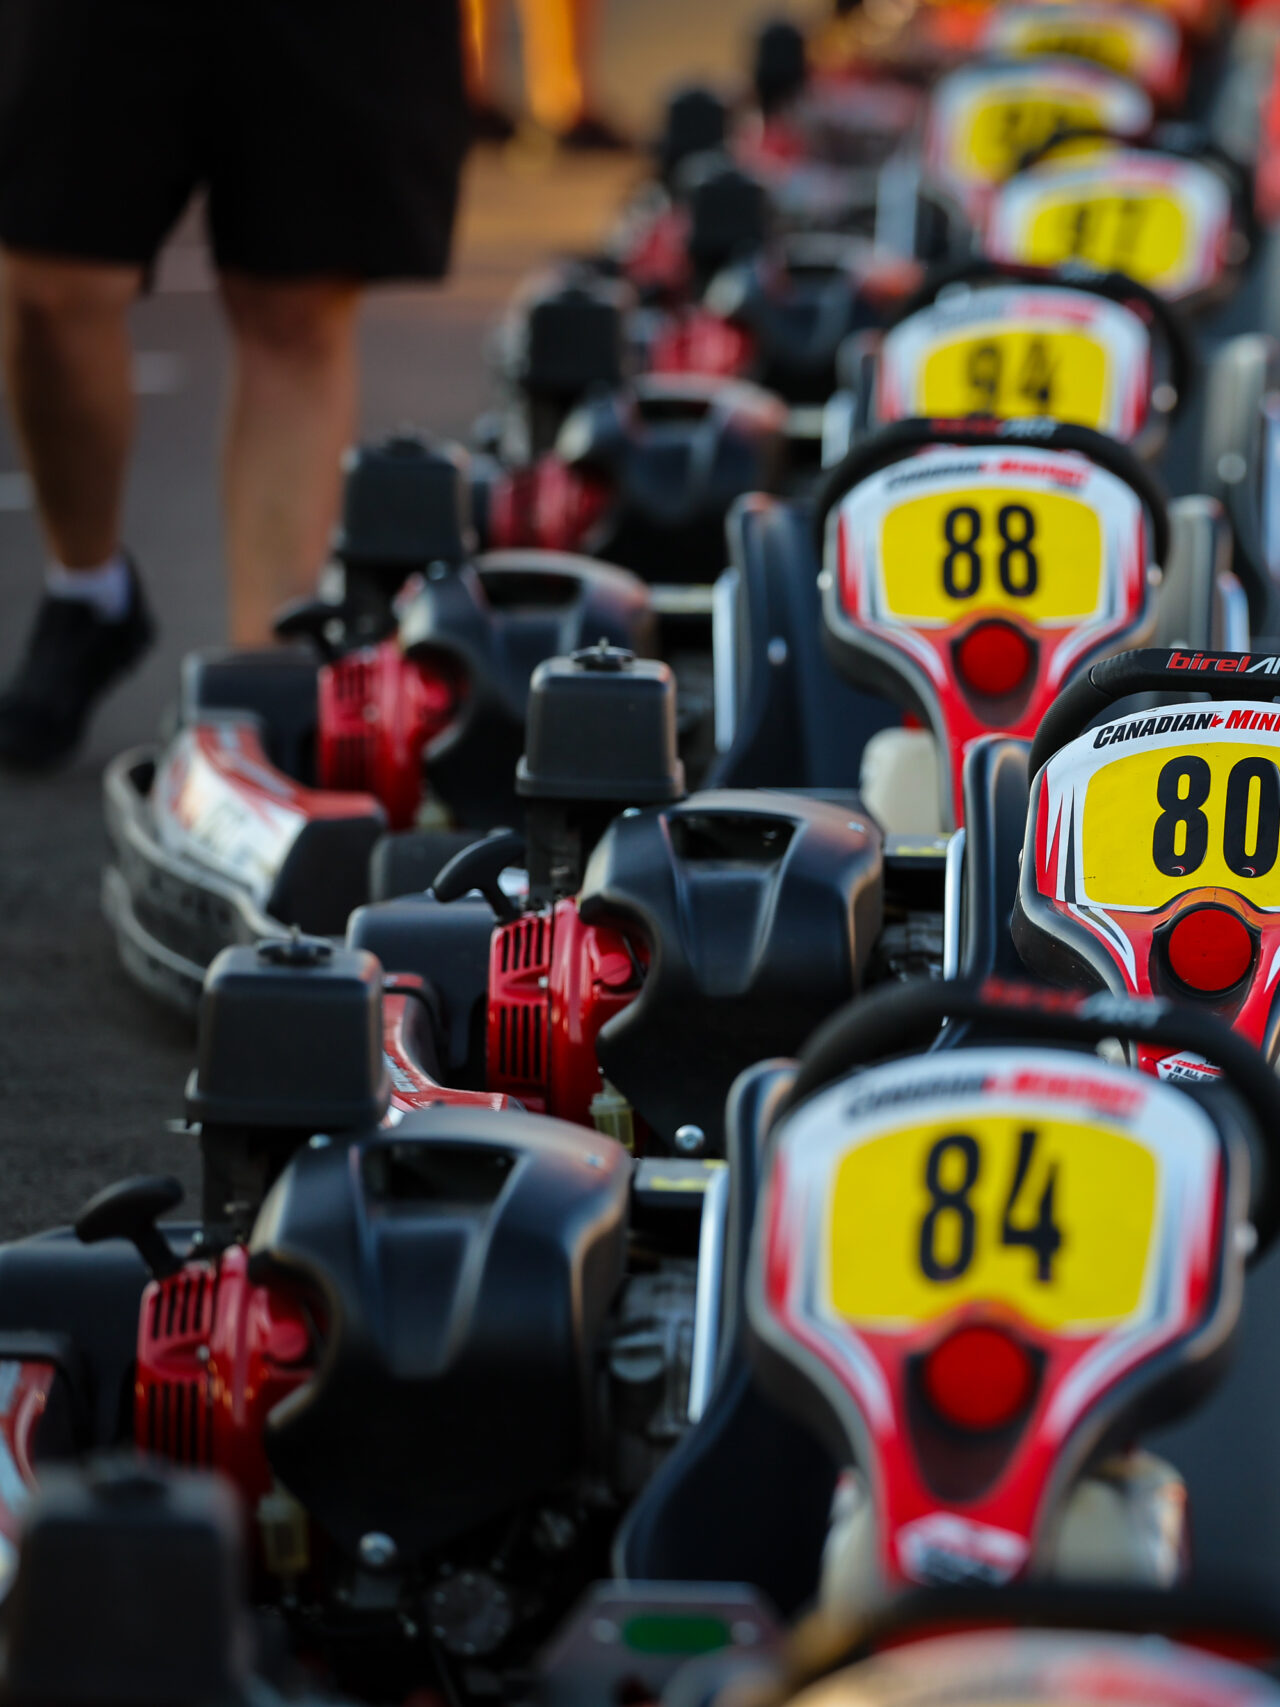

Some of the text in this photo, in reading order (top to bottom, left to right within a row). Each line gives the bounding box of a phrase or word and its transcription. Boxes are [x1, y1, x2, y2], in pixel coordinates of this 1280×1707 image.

[942, 504, 1038, 598] 88
[1093, 712, 1213, 749] CANADIAN
[919, 1129, 1064, 1283] 84
